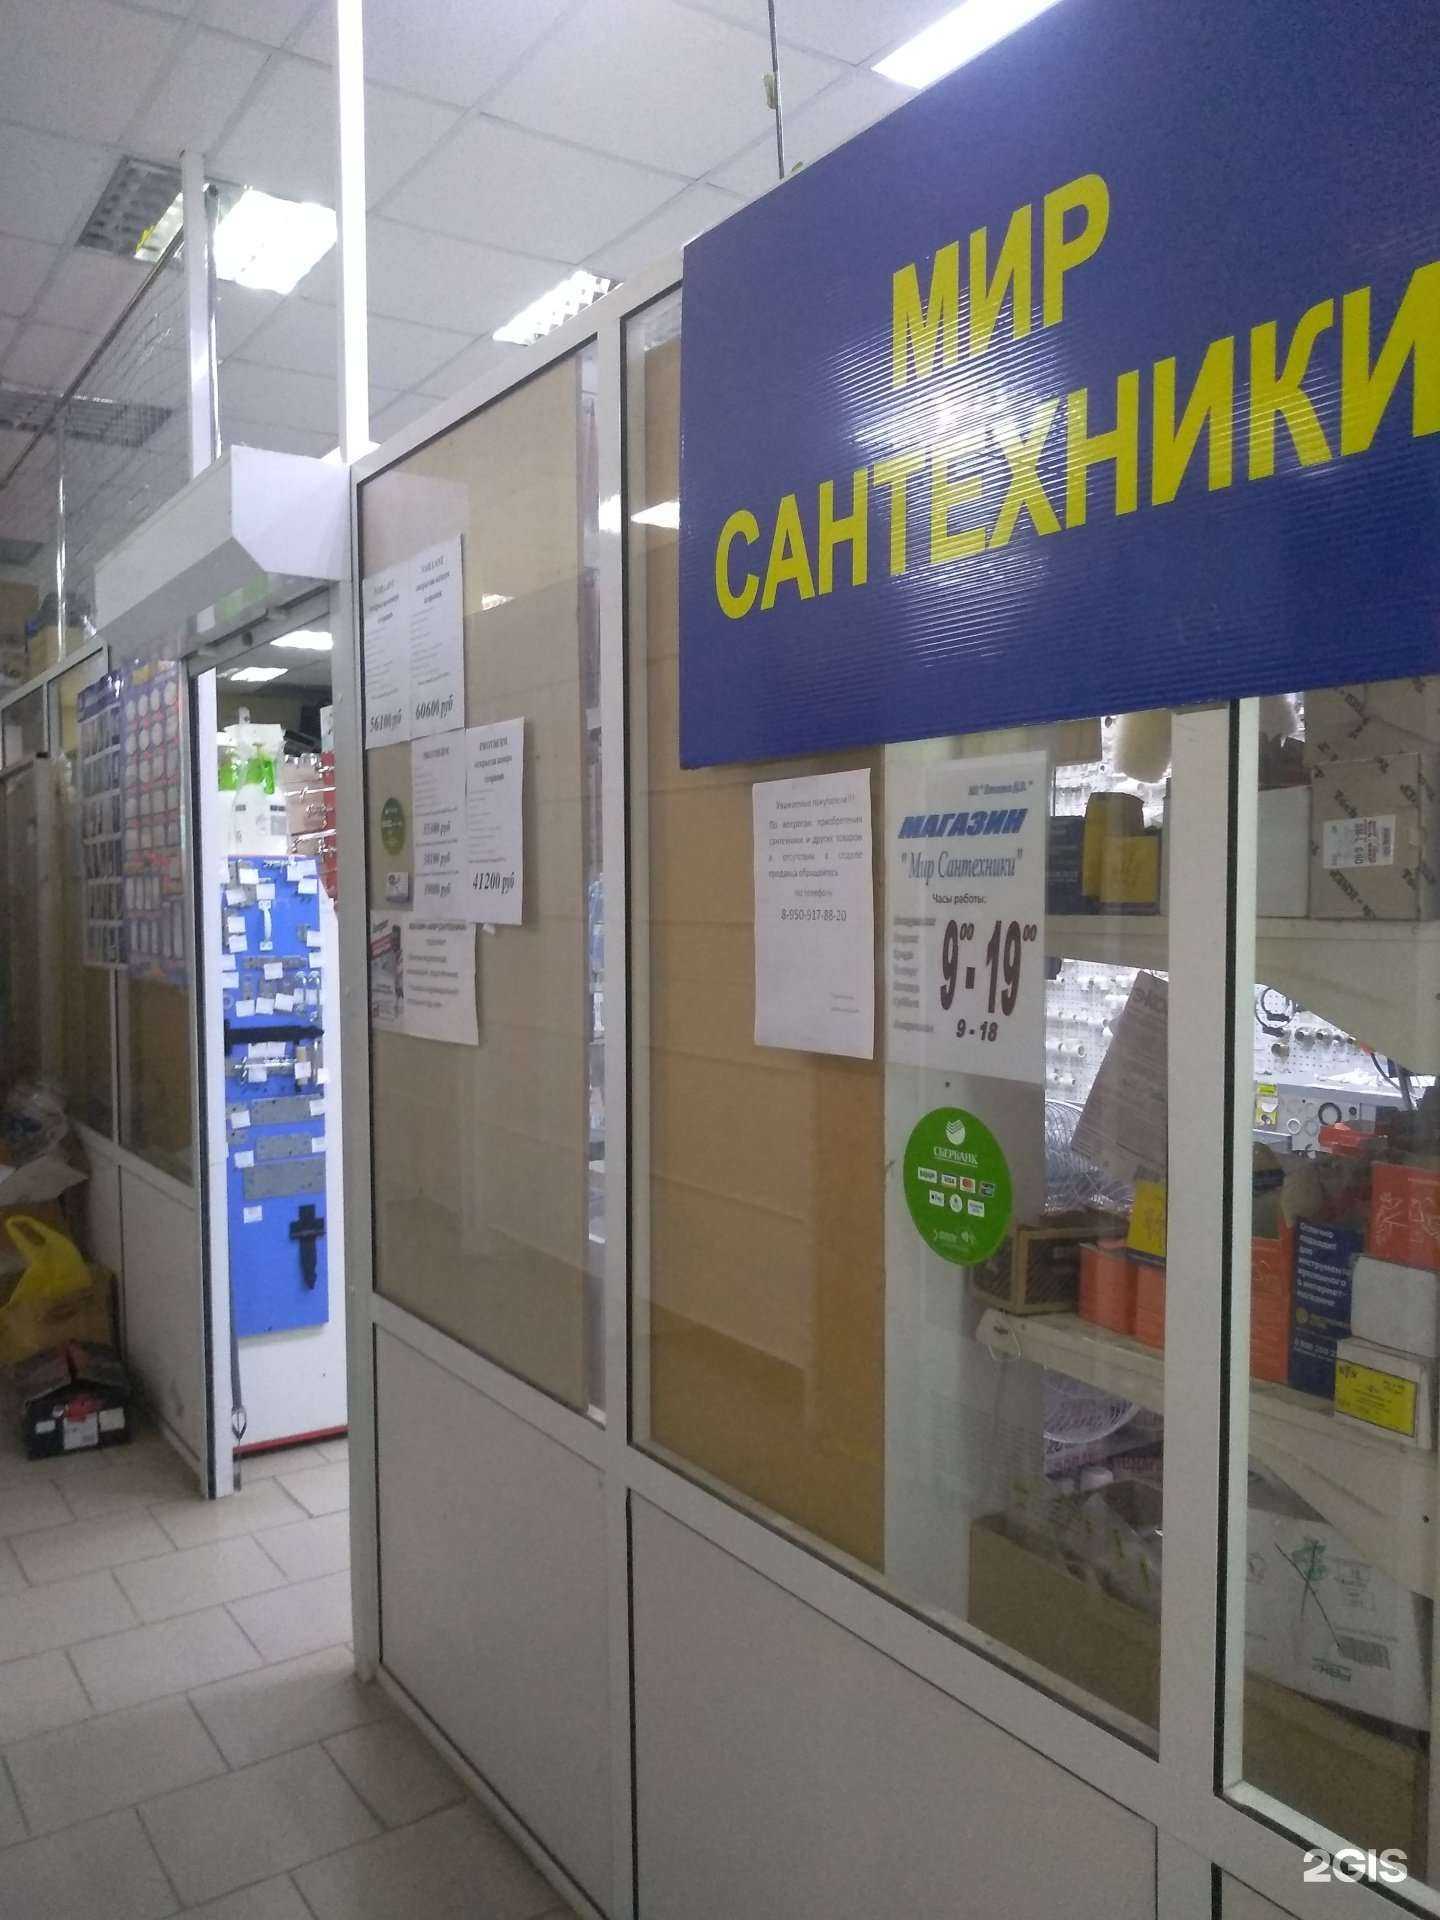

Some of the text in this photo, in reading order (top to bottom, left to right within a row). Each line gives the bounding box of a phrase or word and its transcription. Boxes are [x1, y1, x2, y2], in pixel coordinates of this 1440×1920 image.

[892, 174, 1110, 389] МИР
[715, 262, 1440, 619] САНТЕХНИКИ
[472, 871, 501, 891] 41200
[898, 808, 1028, 839] МАГАЗИН
